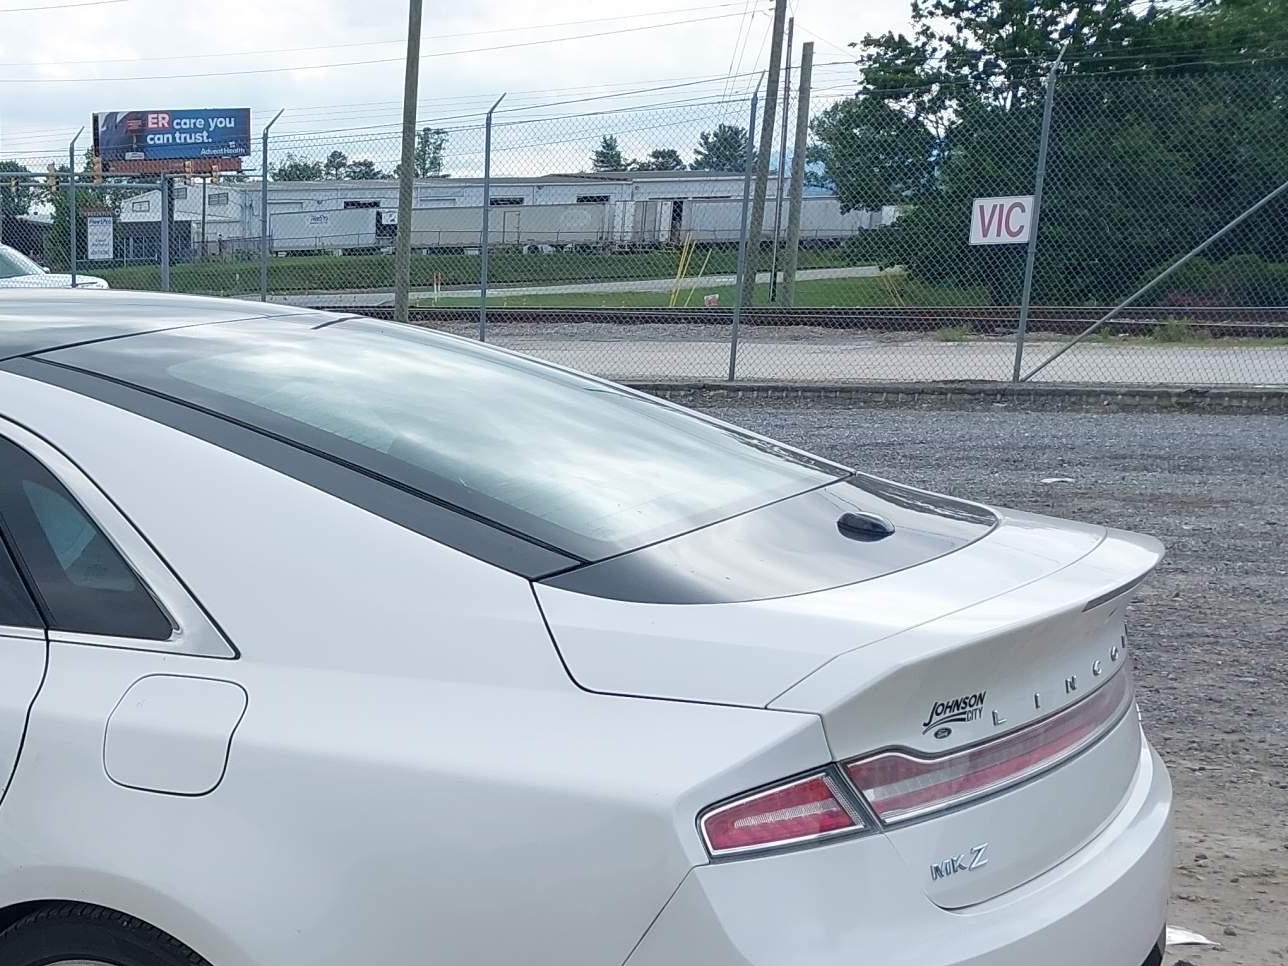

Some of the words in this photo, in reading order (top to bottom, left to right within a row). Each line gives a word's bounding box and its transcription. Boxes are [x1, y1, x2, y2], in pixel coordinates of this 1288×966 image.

[147, 113, 170, 128] ER
[173, 118, 205, 129] care
[208, 117, 235, 131] you
[146, 133, 173, 144] can
[174, 130, 212, 143] trust.
[979, 202, 1026, 238] VIC
[991, 623, 1128, 727] LINCO
[923, 691, 986, 727] JOHNSON
[966, 707, 983, 722] CITY
